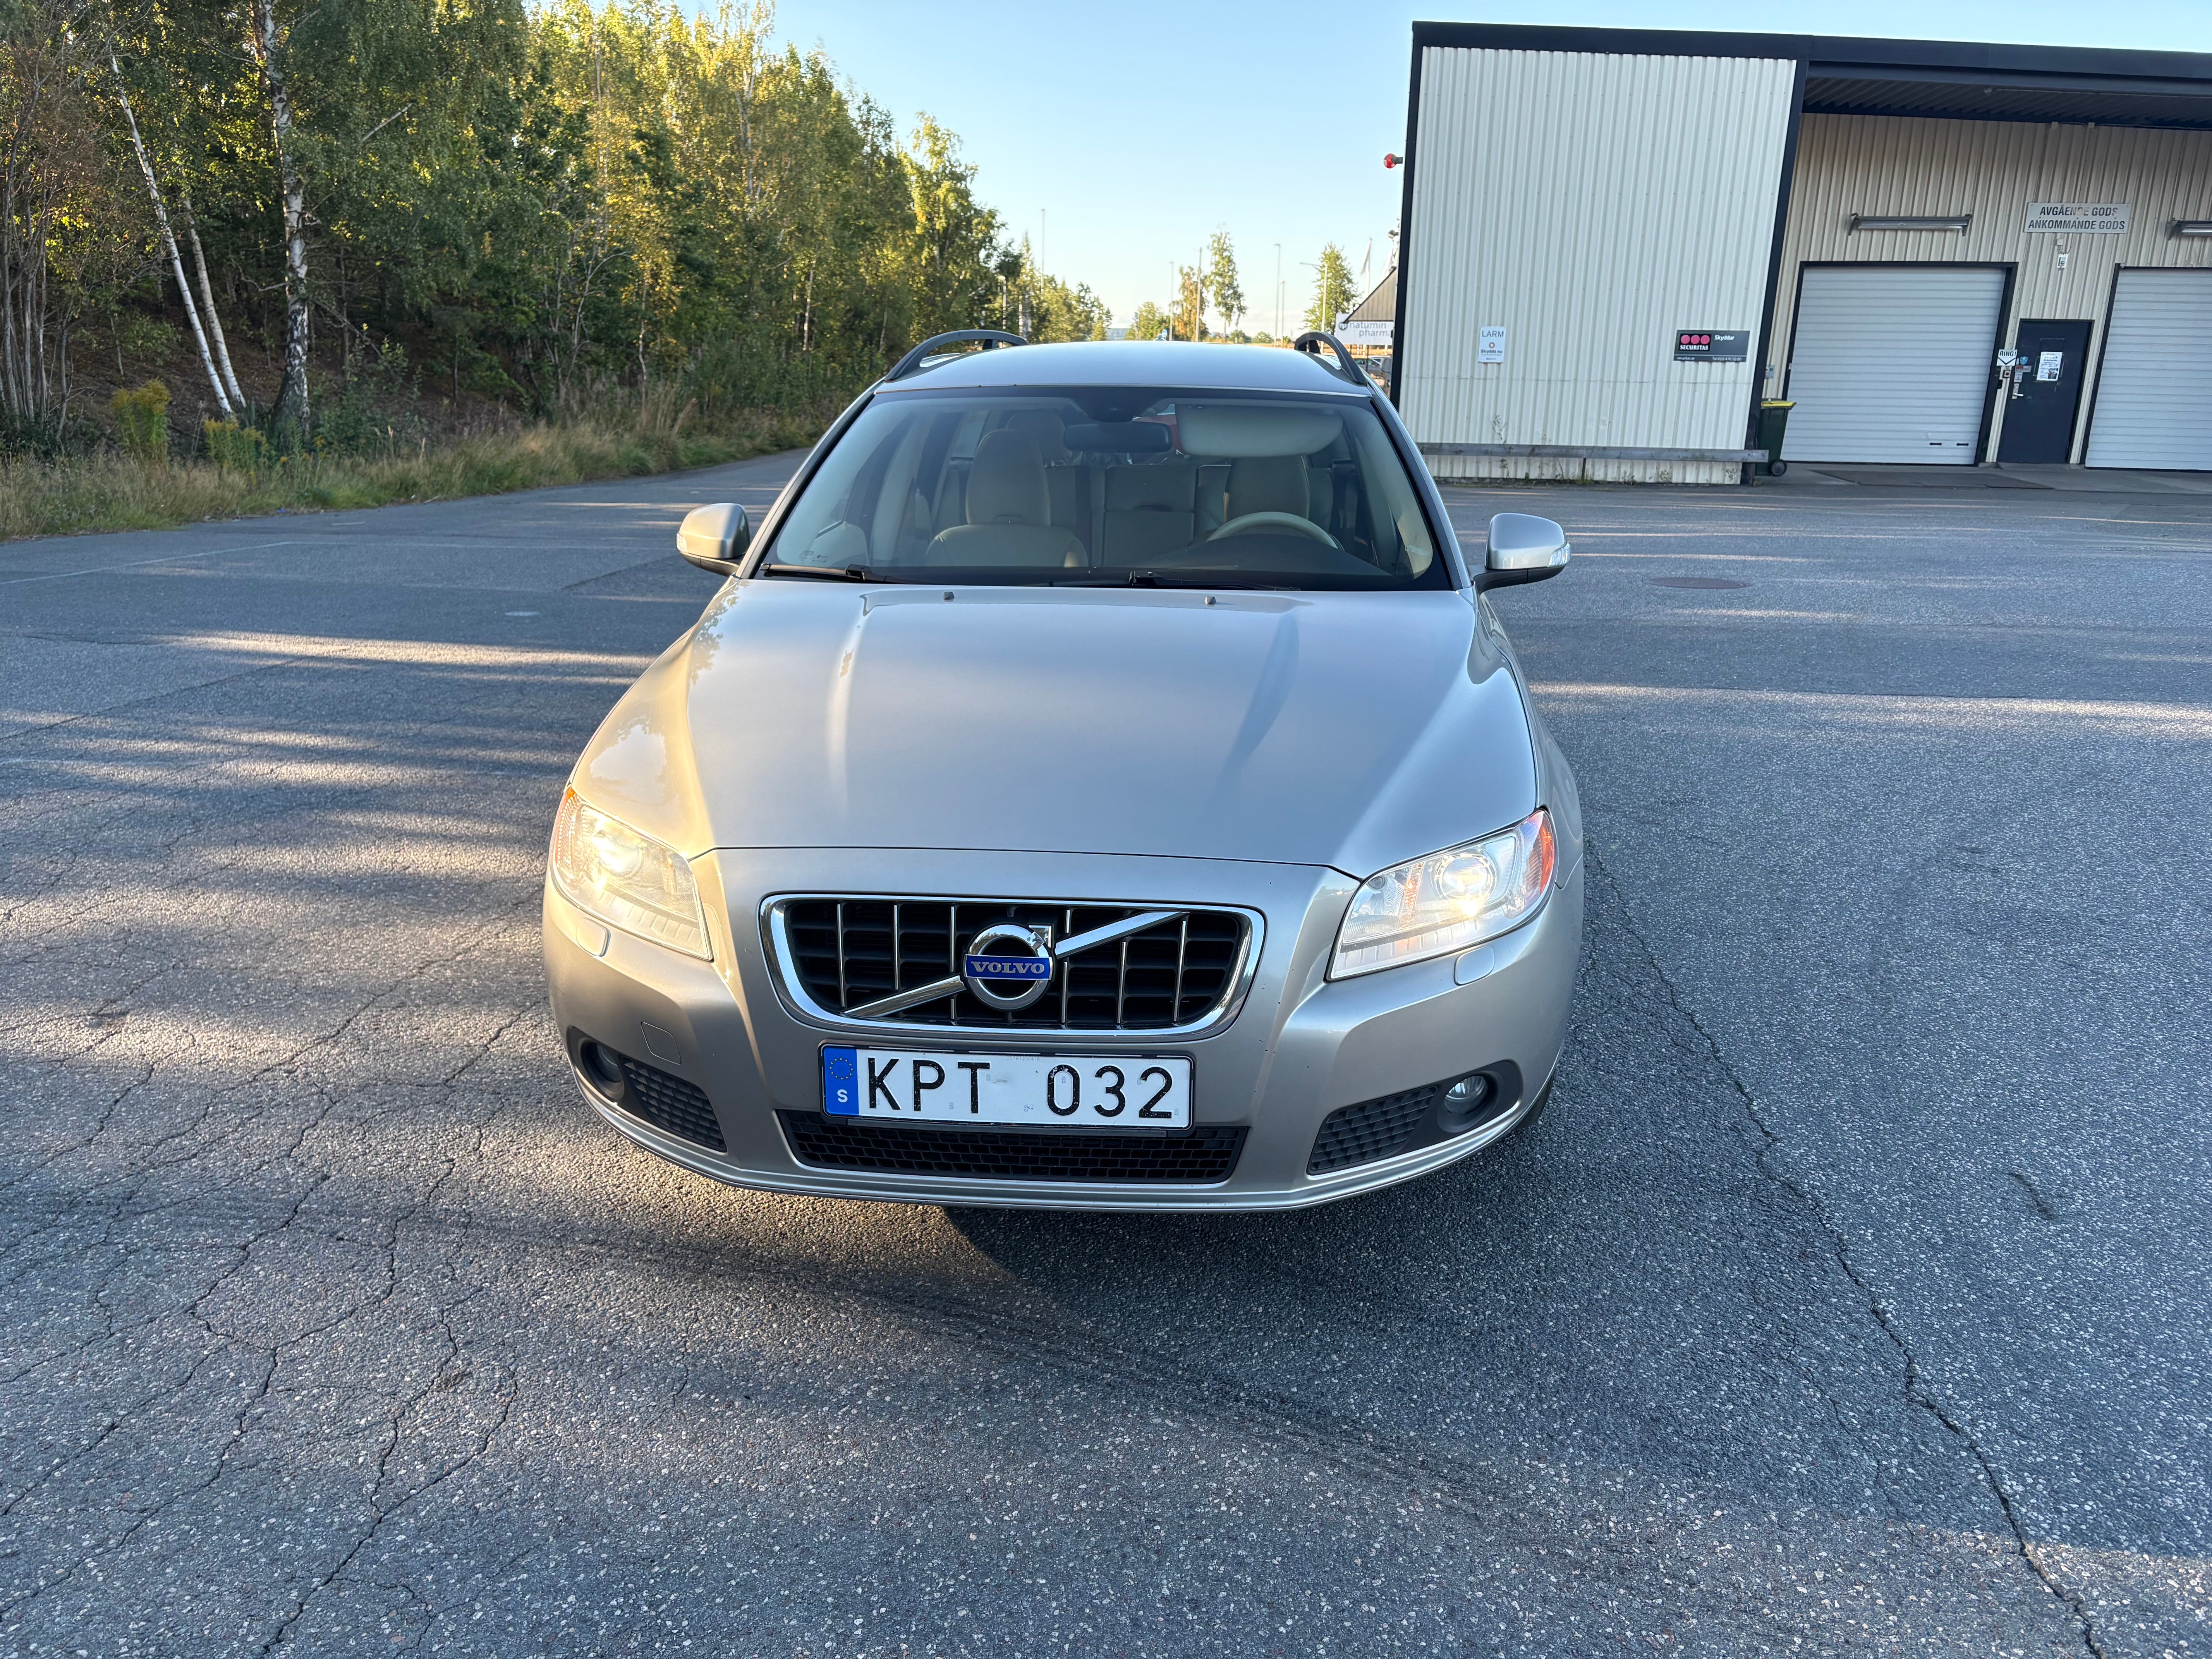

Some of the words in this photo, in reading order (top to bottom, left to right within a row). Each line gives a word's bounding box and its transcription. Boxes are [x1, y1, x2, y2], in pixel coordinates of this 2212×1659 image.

[2092, 207, 2118, 216] GODS
[2028, 220, 2097, 229] ANKOMMANDE
[2099, 220, 2125, 230] GODS
[971, 961, 1045, 974] VOLVO
[868, 1057, 990, 1113] KPT
[1047, 1064, 1173, 1118] 032
[837, 1089, 848, 1103] S
